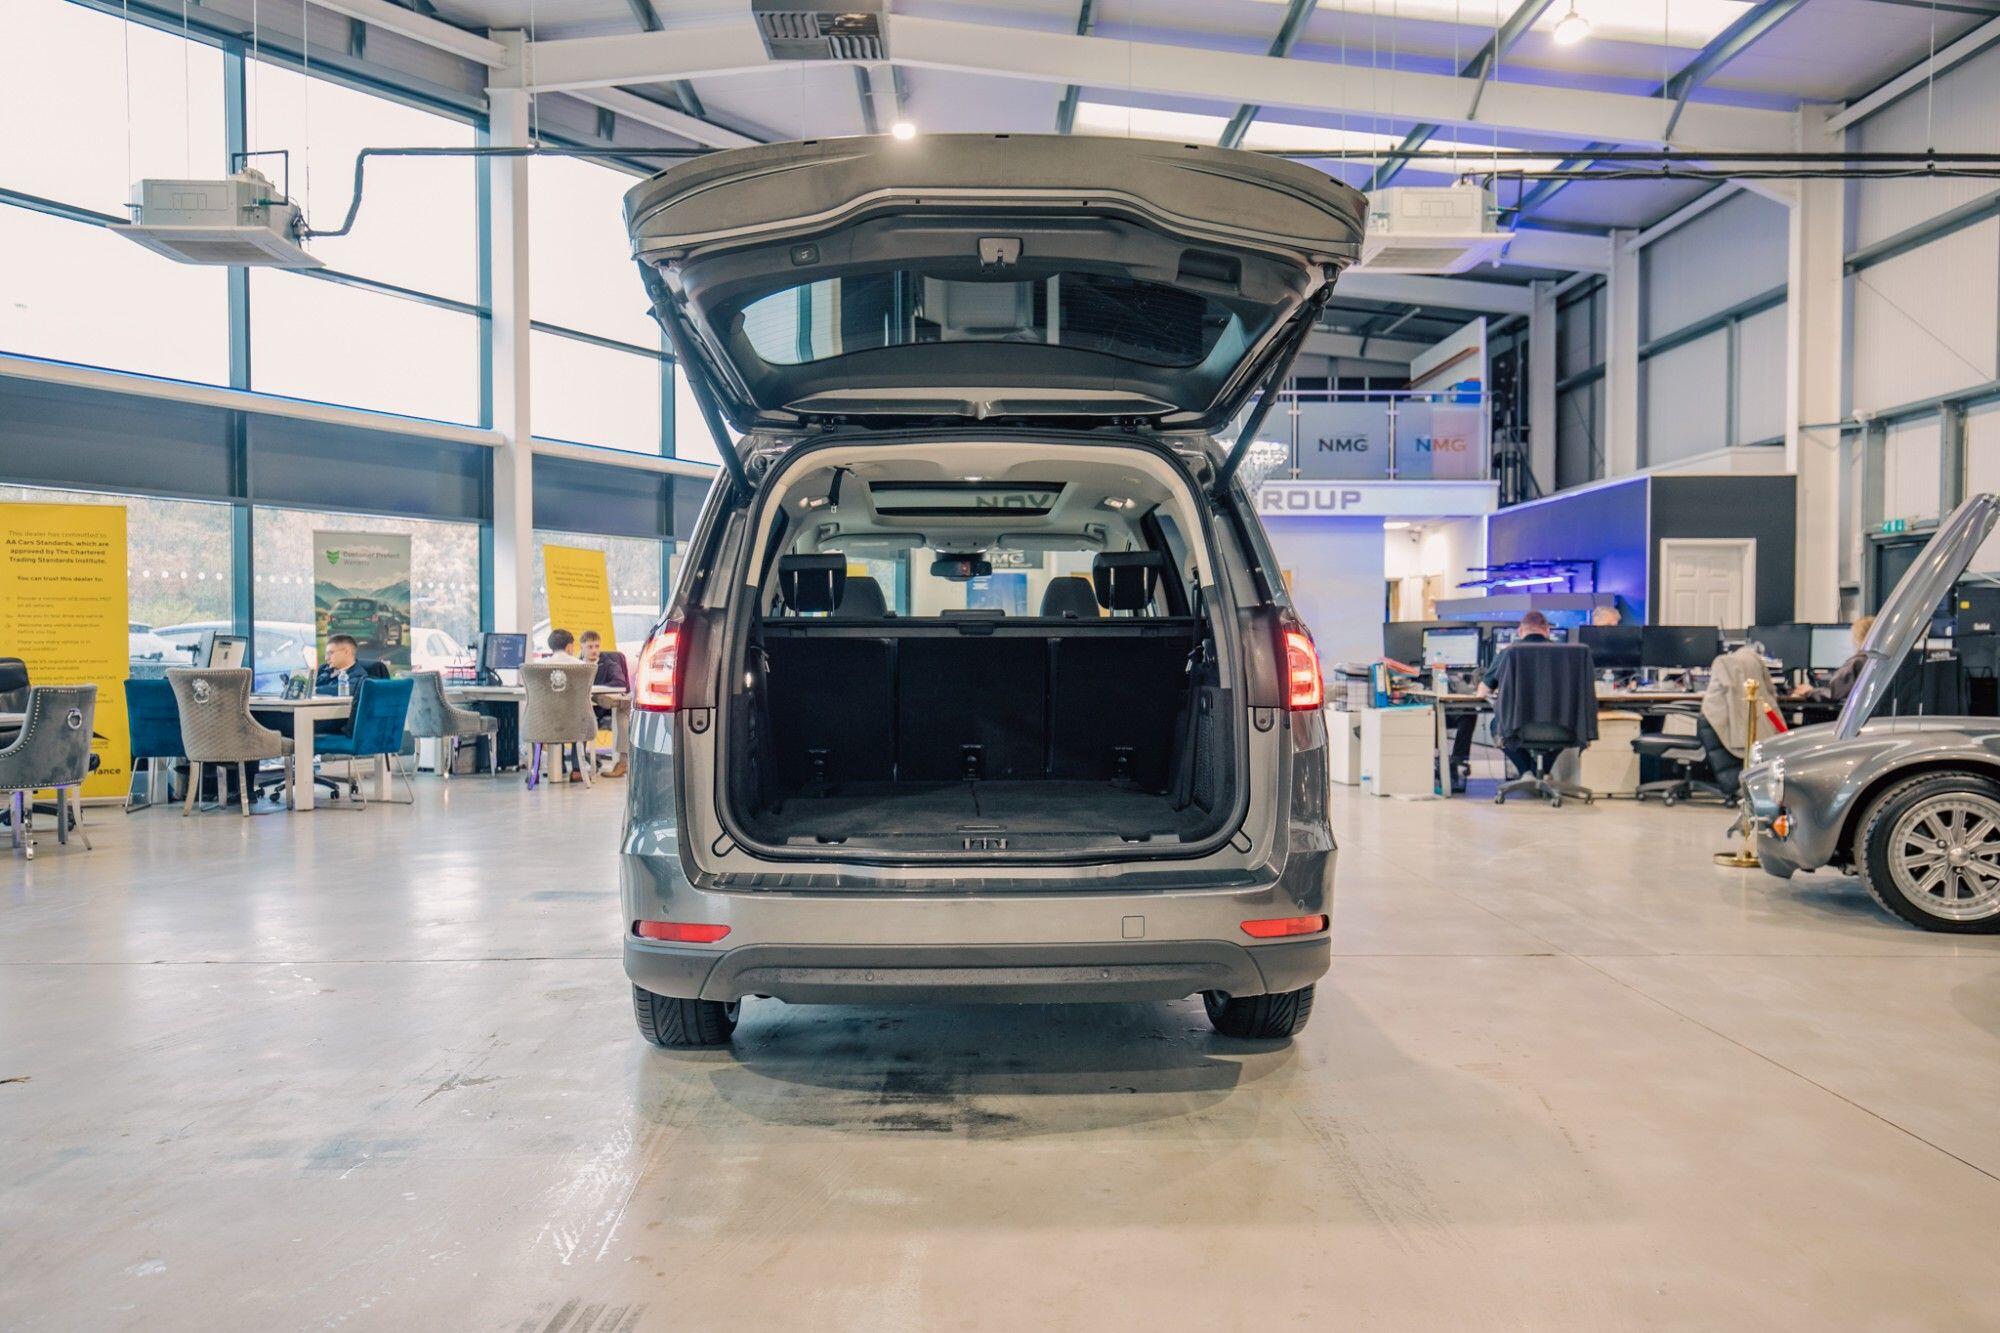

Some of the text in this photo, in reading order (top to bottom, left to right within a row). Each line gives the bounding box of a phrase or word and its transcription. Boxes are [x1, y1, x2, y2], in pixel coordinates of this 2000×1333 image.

[1318, 438, 1369, 452] NMG
[1415, 438, 1467, 452] NMG
[1262, 490, 1361, 510] ROUP
